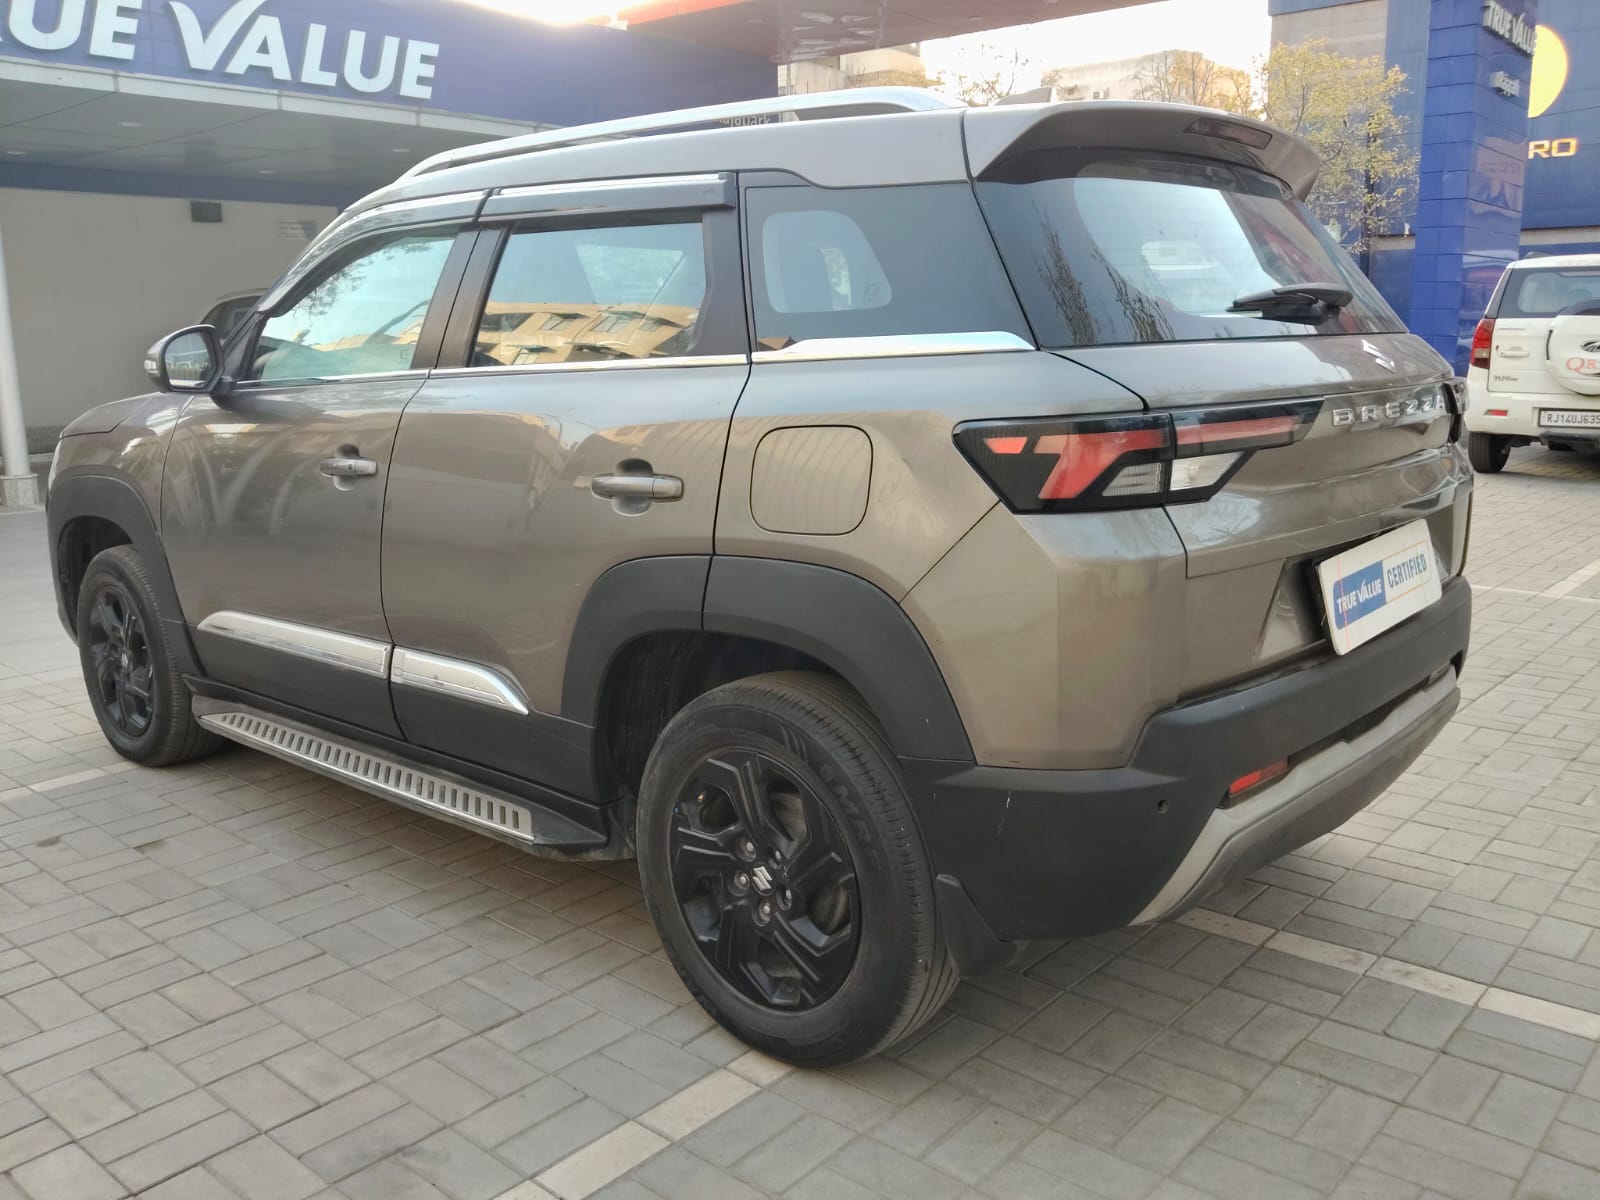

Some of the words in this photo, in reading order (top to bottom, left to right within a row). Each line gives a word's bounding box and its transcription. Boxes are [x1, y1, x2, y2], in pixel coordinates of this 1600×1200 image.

[1484, 2, 1511, 39] TRUE
[168, 0, 440, 99] VALUE
[1528, 138, 1577, 159] RO
[1332, 395, 1445, 426] BREZZA
[1336, 590, 1358, 614] TRUE
[1357, 578, 1382, 603] VALUE
[1387, 553, 1427, 588] CERTIFIED
